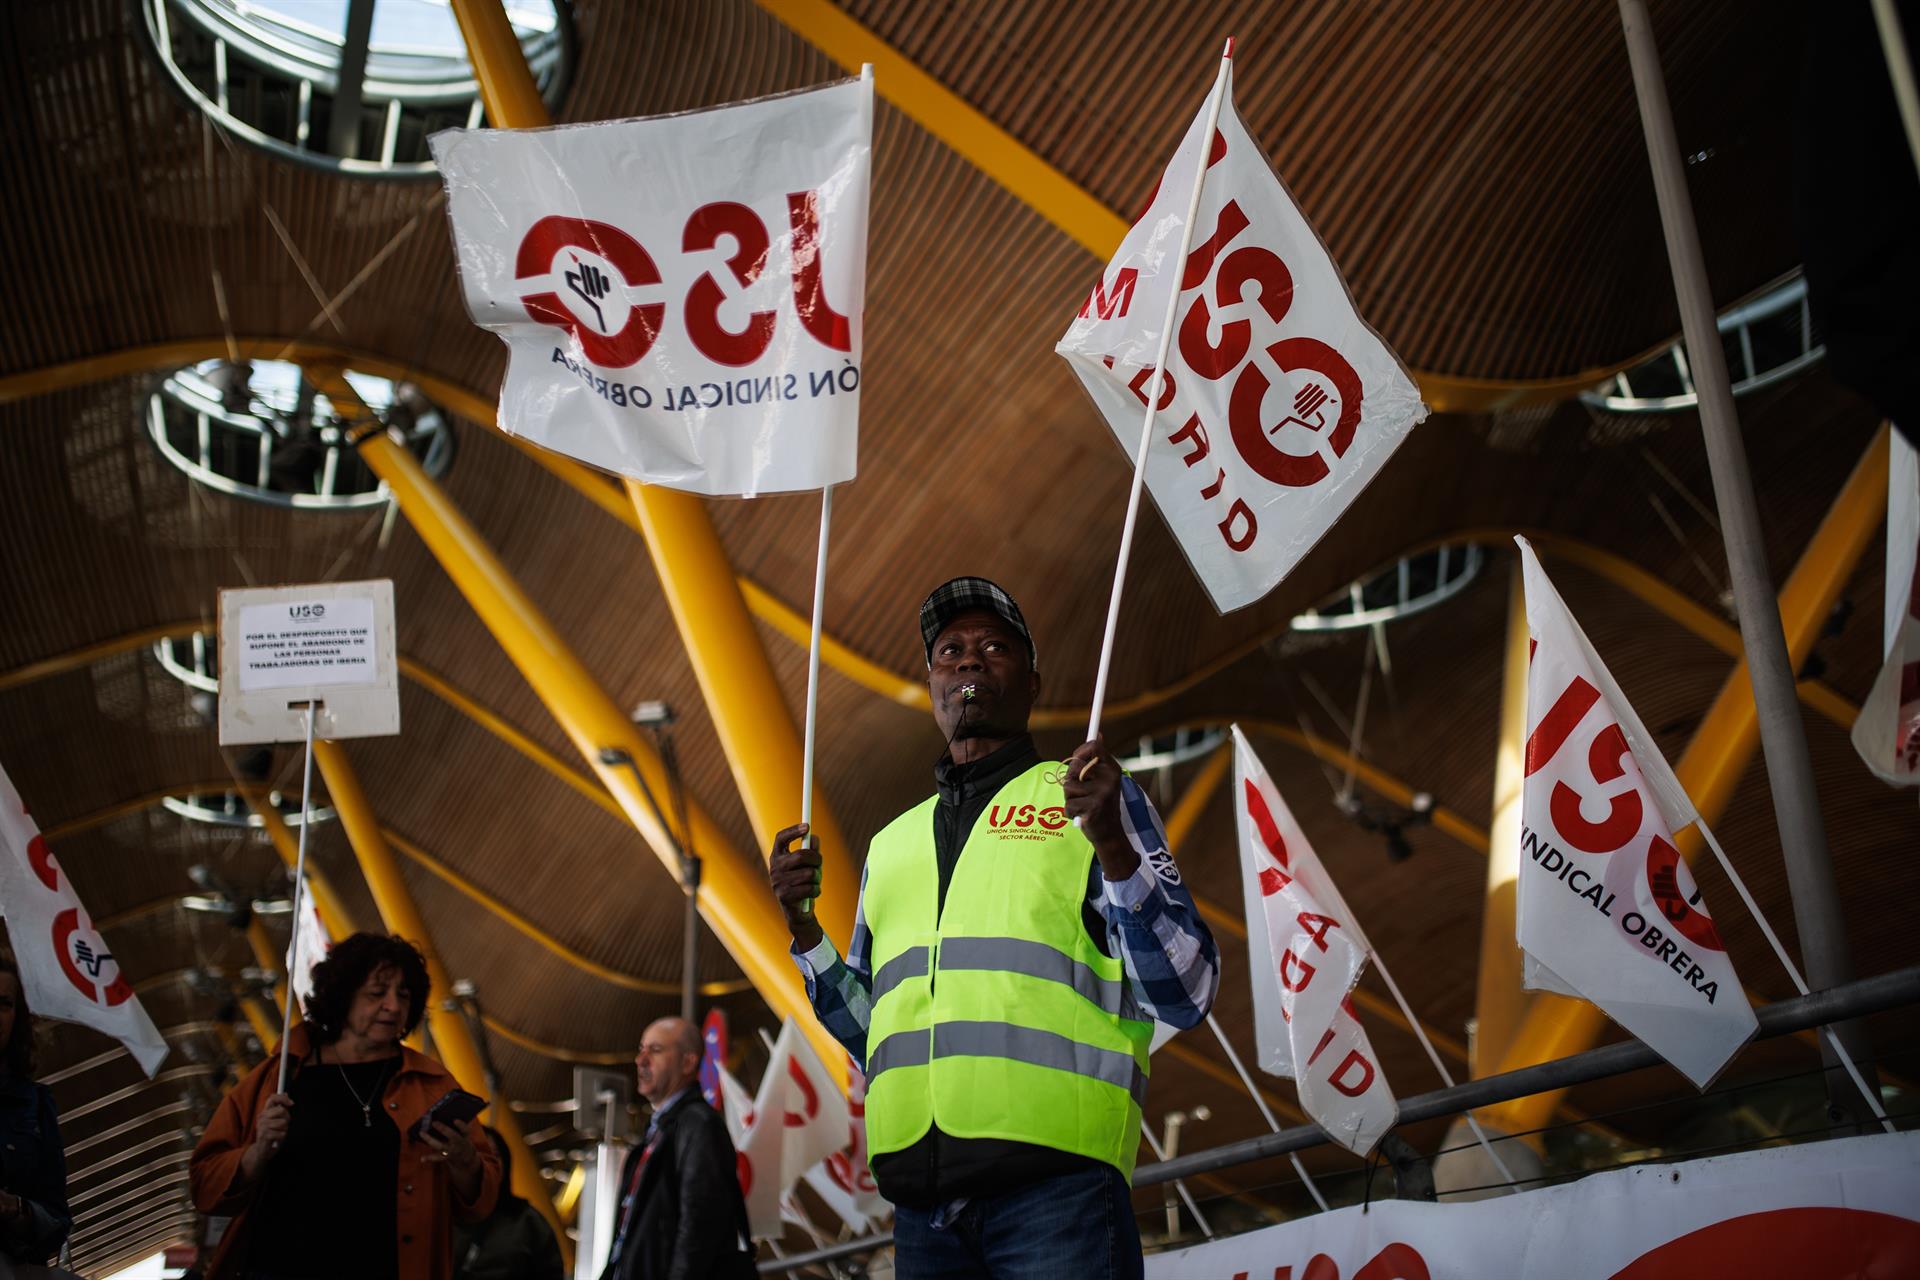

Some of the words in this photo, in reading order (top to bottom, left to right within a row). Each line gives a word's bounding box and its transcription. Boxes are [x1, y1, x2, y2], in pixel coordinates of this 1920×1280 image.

[289, 604, 325, 618] USO
[246, 632, 265, 640] POR
[267, 632, 277, 640] EL
[349, 628, 368, 636] QUE
[250, 642, 286, 650] SUPONE
[302, 639, 351, 647] ABANDONO
[294, 649, 341, 657] PERSONAS
[249, 659, 320, 669] TRABAJADORAS
[322, 658, 334, 666] DE
[337, 657, 367, 665] IBERIA
[989, 804, 1068, 830] USO
[1039, 829, 1064, 838] OBRERA
[1521, 825, 1617, 918] INDICAL
[1622, 912, 1718, 1005] OBRERA
